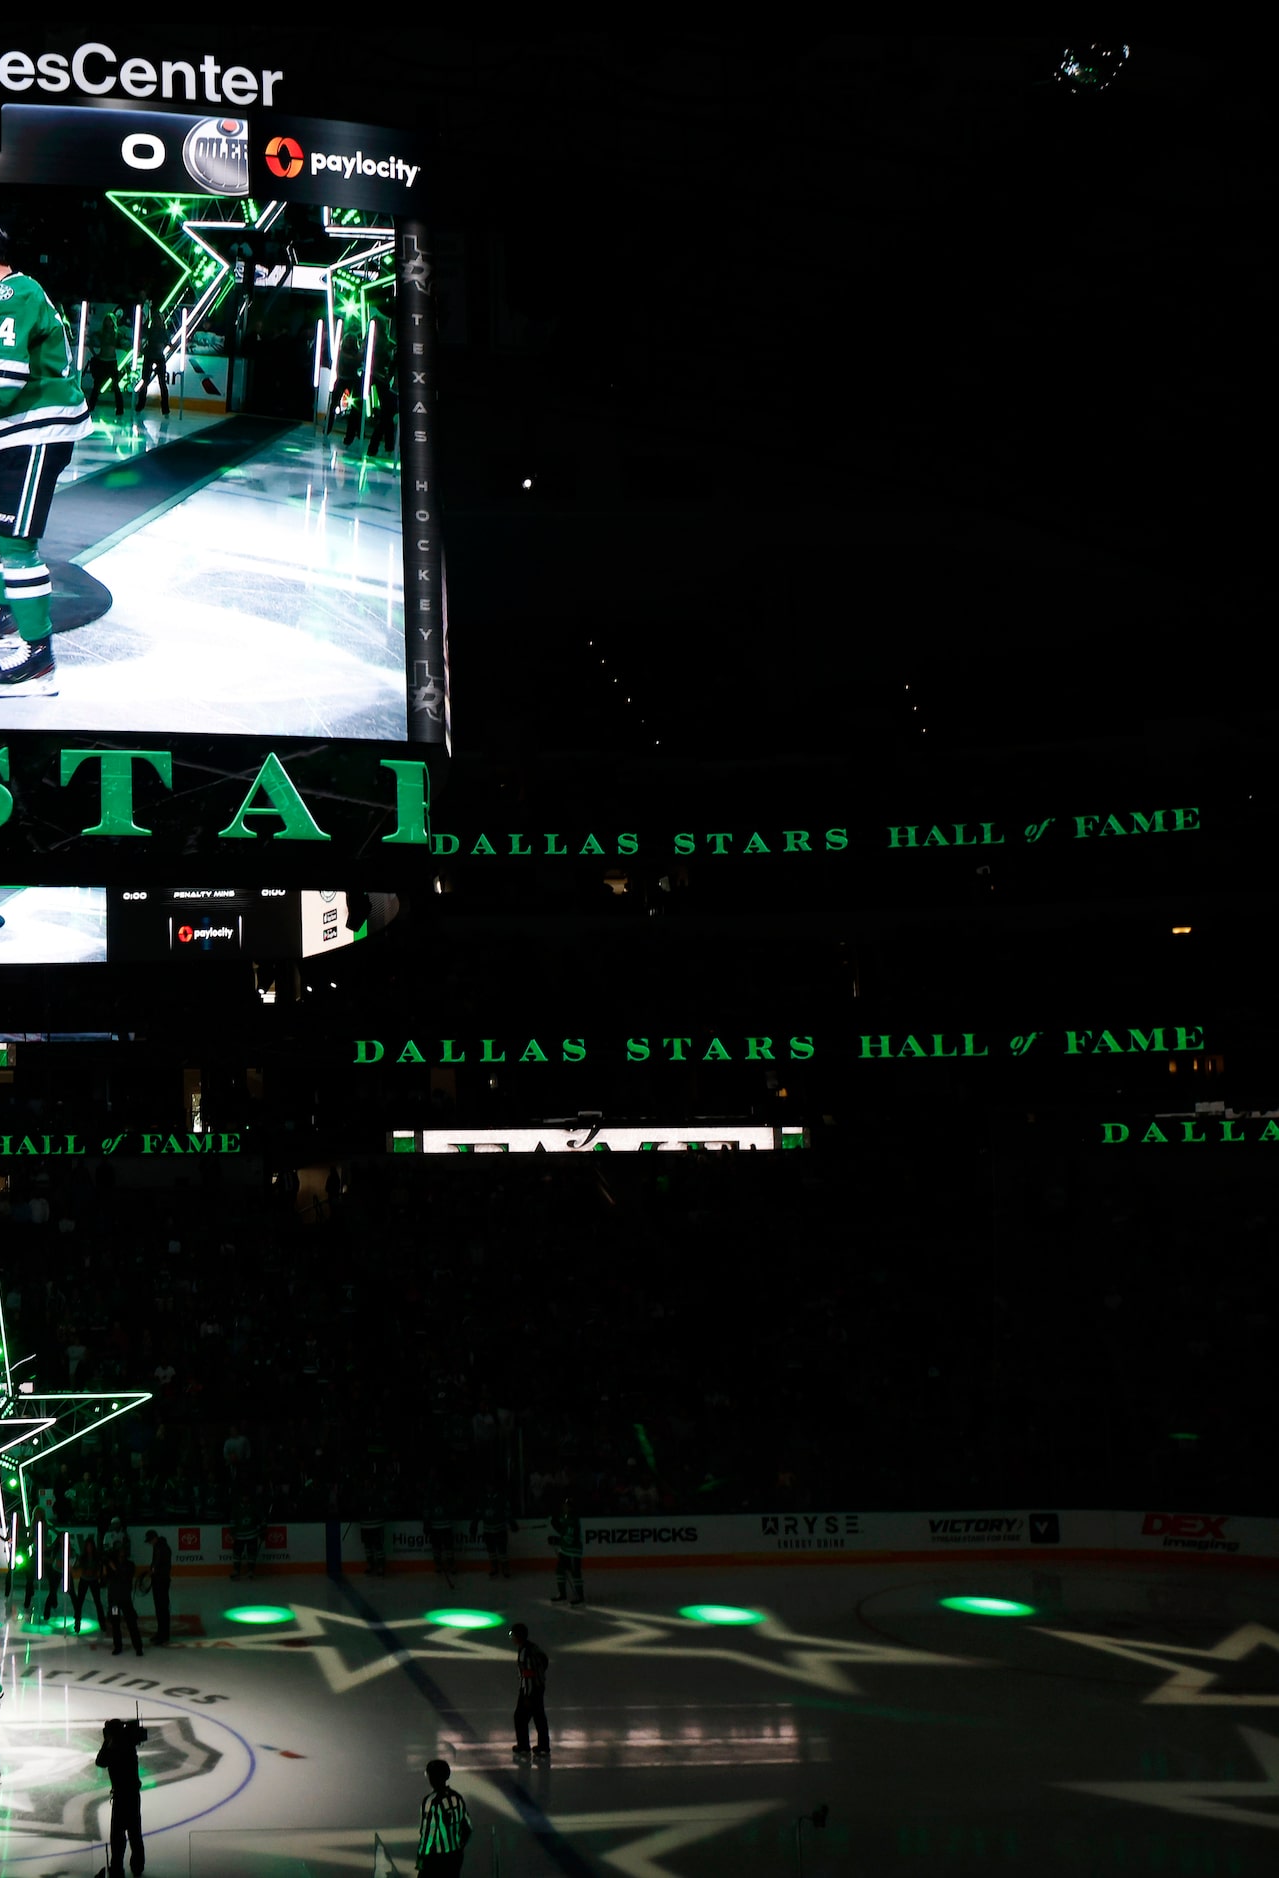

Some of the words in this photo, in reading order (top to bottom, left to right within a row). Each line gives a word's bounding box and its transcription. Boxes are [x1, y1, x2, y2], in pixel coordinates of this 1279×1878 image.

[120, 132, 166, 170] 0
[310, 150, 420, 188] paylocity
[410, 313, 429, 443] TEXAS
[415, 480, 434, 642] HOCKEY
[432, 832, 640, 856] DALLAS
[674, 828, 850, 855] STARS
[888, 823, 1006, 849] HALL
[1023, 817, 1057, 844] of
[1074, 807, 1202, 838] FAME
[122, 892, 148, 900] 0:00
[173, 891, 211, 899] PENALTY
[213, 890, 236, 898] MINS
[193, 926, 234, 940] paylocity
[352, 1038, 587, 1064] DALLAS
[626, 1036, 816, 1062] STARS
[859, 1033, 989, 1058] HALL
[1009, 1030, 1042, 1057] of
[1064, 1026, 1206, 1056] FAME
[101, 1134, 129, 1156] of
[141, 1132, 241, 1155] FAME
[584, 1526, 698, 1545] PRIZEPICKS
[784, 1515, 860, 1535] RYSE
[1141, 1511, 1230, 1540] DEX
[1163, 1536, 1240, 1553] imaging
[21, 1664, 231, 1706] irlines
